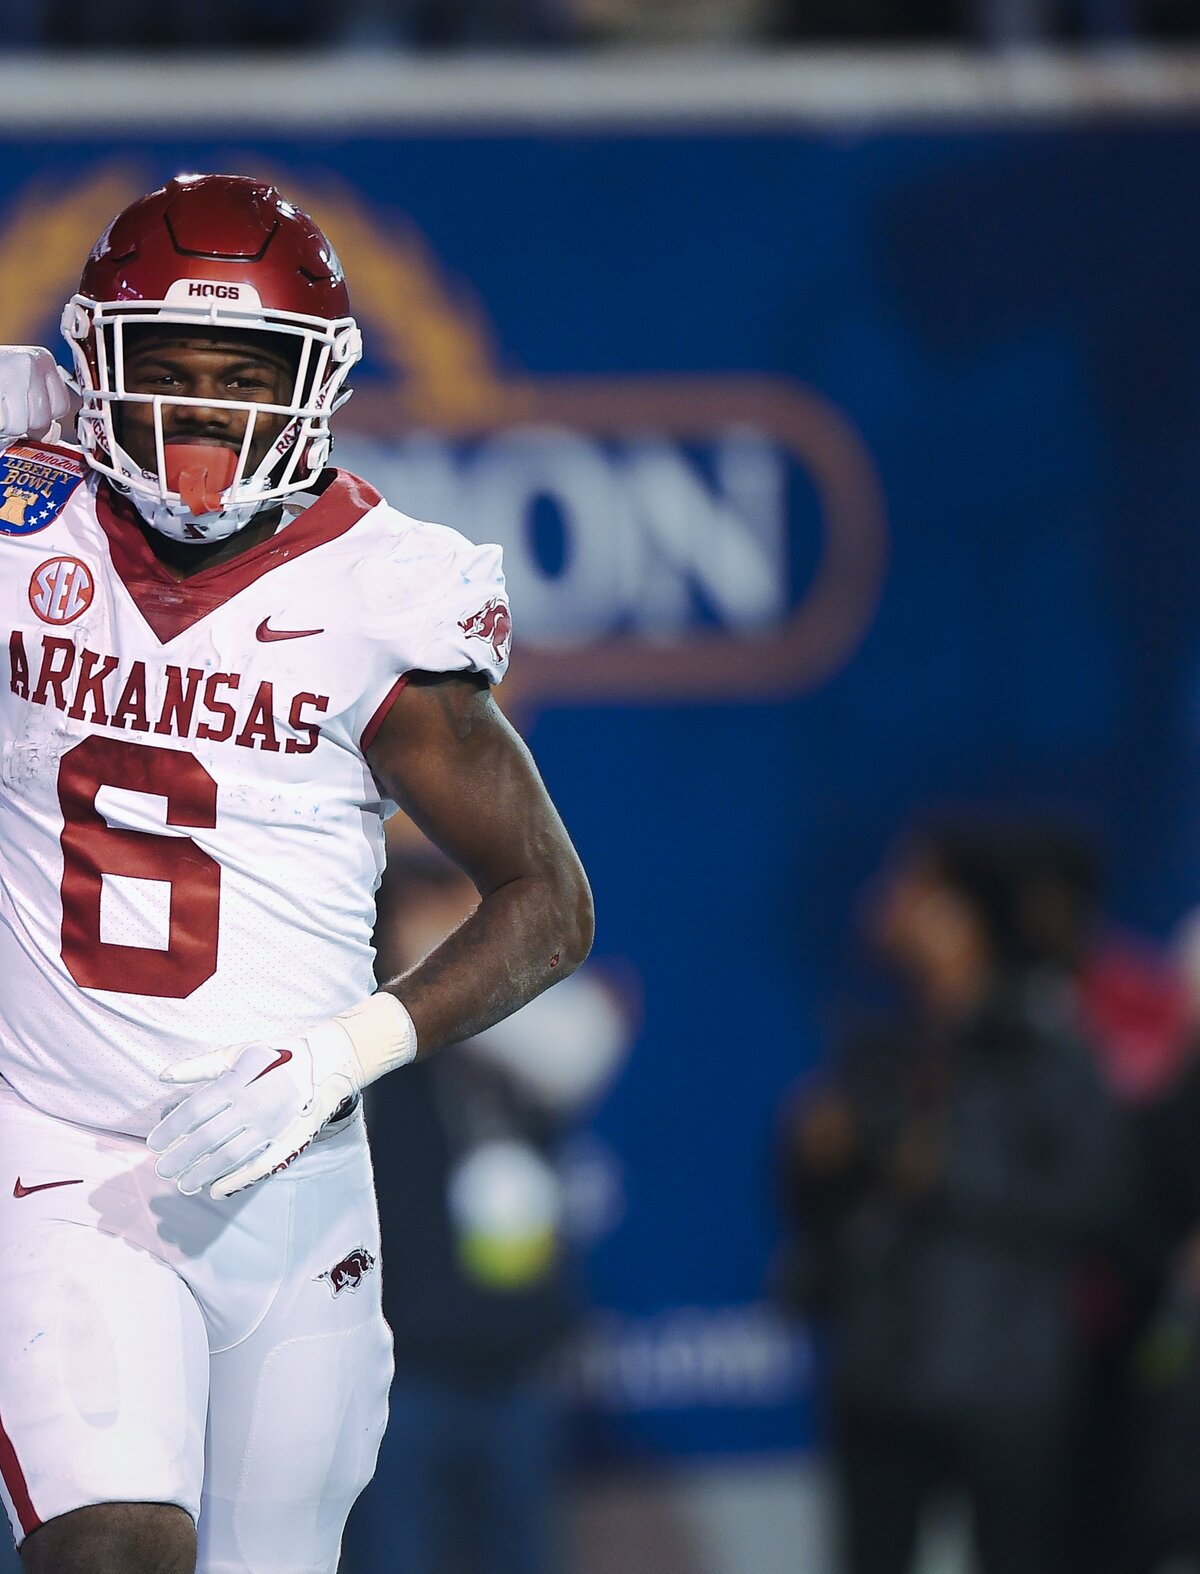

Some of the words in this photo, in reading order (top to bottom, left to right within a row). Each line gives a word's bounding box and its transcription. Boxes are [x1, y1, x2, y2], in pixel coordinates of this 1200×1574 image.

[188, 283, 239, 300] HOGS
[0, 469, 55, 499] BOWL
[3, 458, 74, 484] LIBERTY
[34, 560, 90, 620] SEC
[9, 630, 329, 754] ARKANSAS
[57, 734, 221, 999] 6
